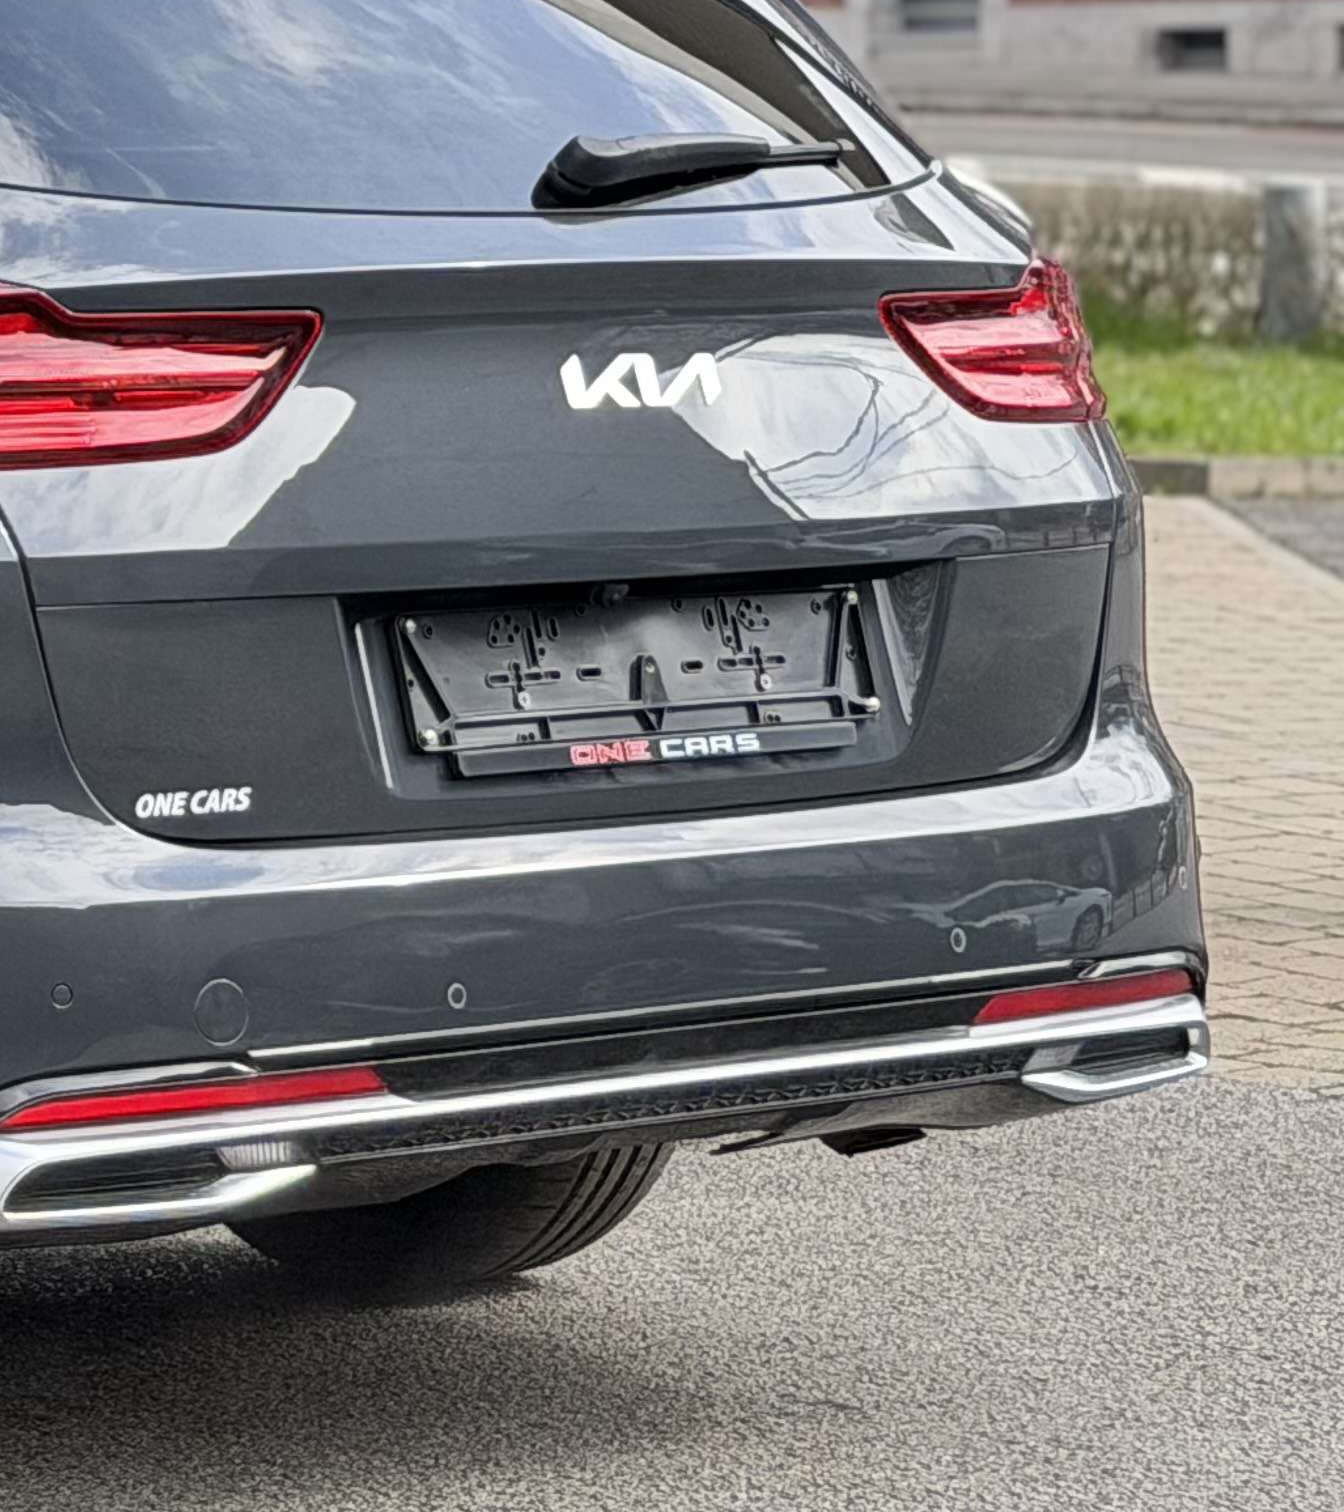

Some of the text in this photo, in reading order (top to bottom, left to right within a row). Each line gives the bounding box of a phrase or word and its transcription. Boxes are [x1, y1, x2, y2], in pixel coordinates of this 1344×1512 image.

[570, 733, 761, 767] ONE CARS
[134, 786, 253, 819] ONE CARS
